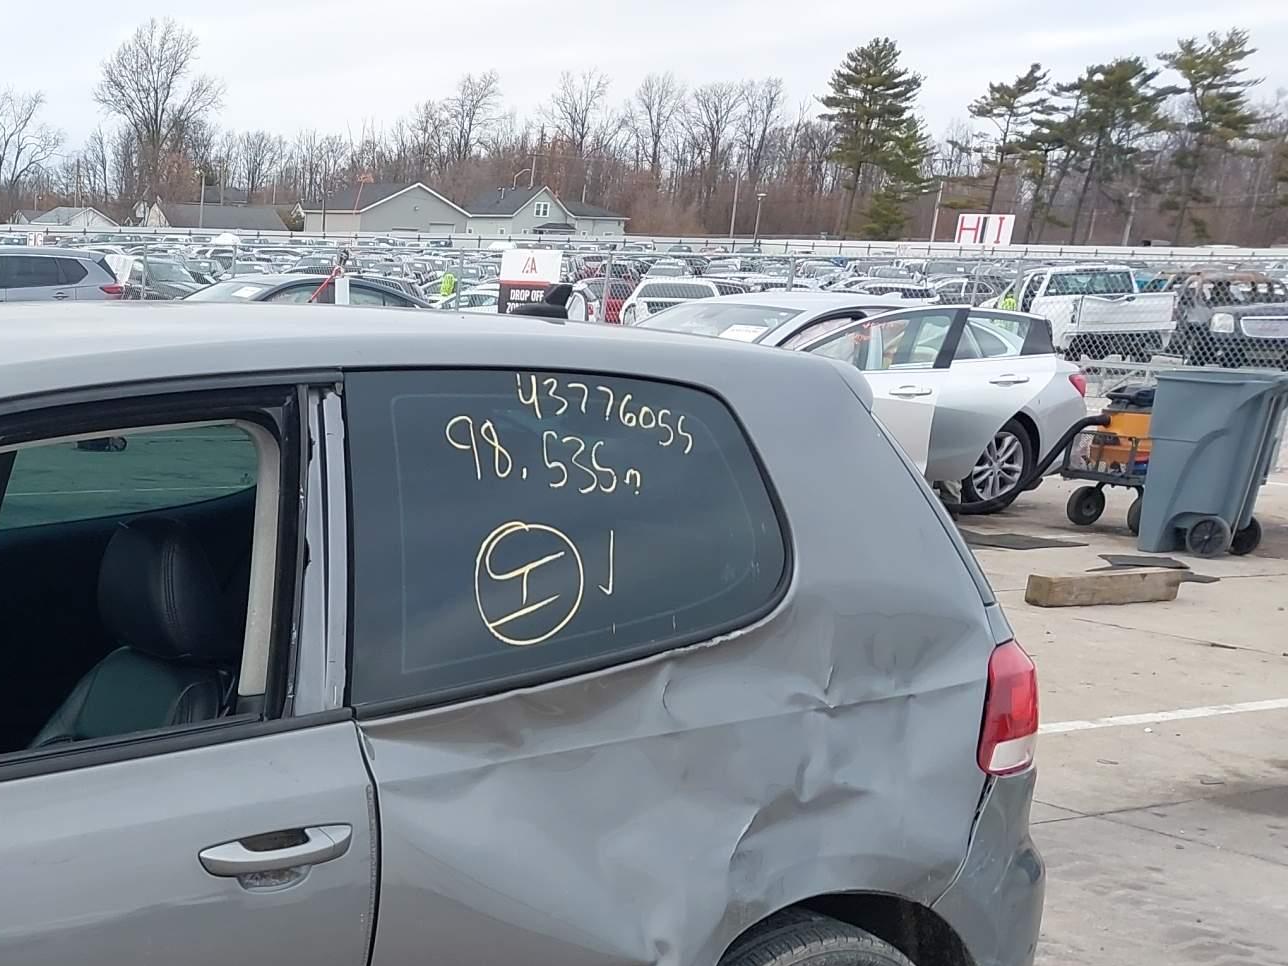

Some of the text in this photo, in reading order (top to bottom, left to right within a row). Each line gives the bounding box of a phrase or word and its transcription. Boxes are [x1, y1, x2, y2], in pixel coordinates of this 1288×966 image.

[510, 289, 545, 302] DROP OFF
[516, 373, 693, 454] 43776055
